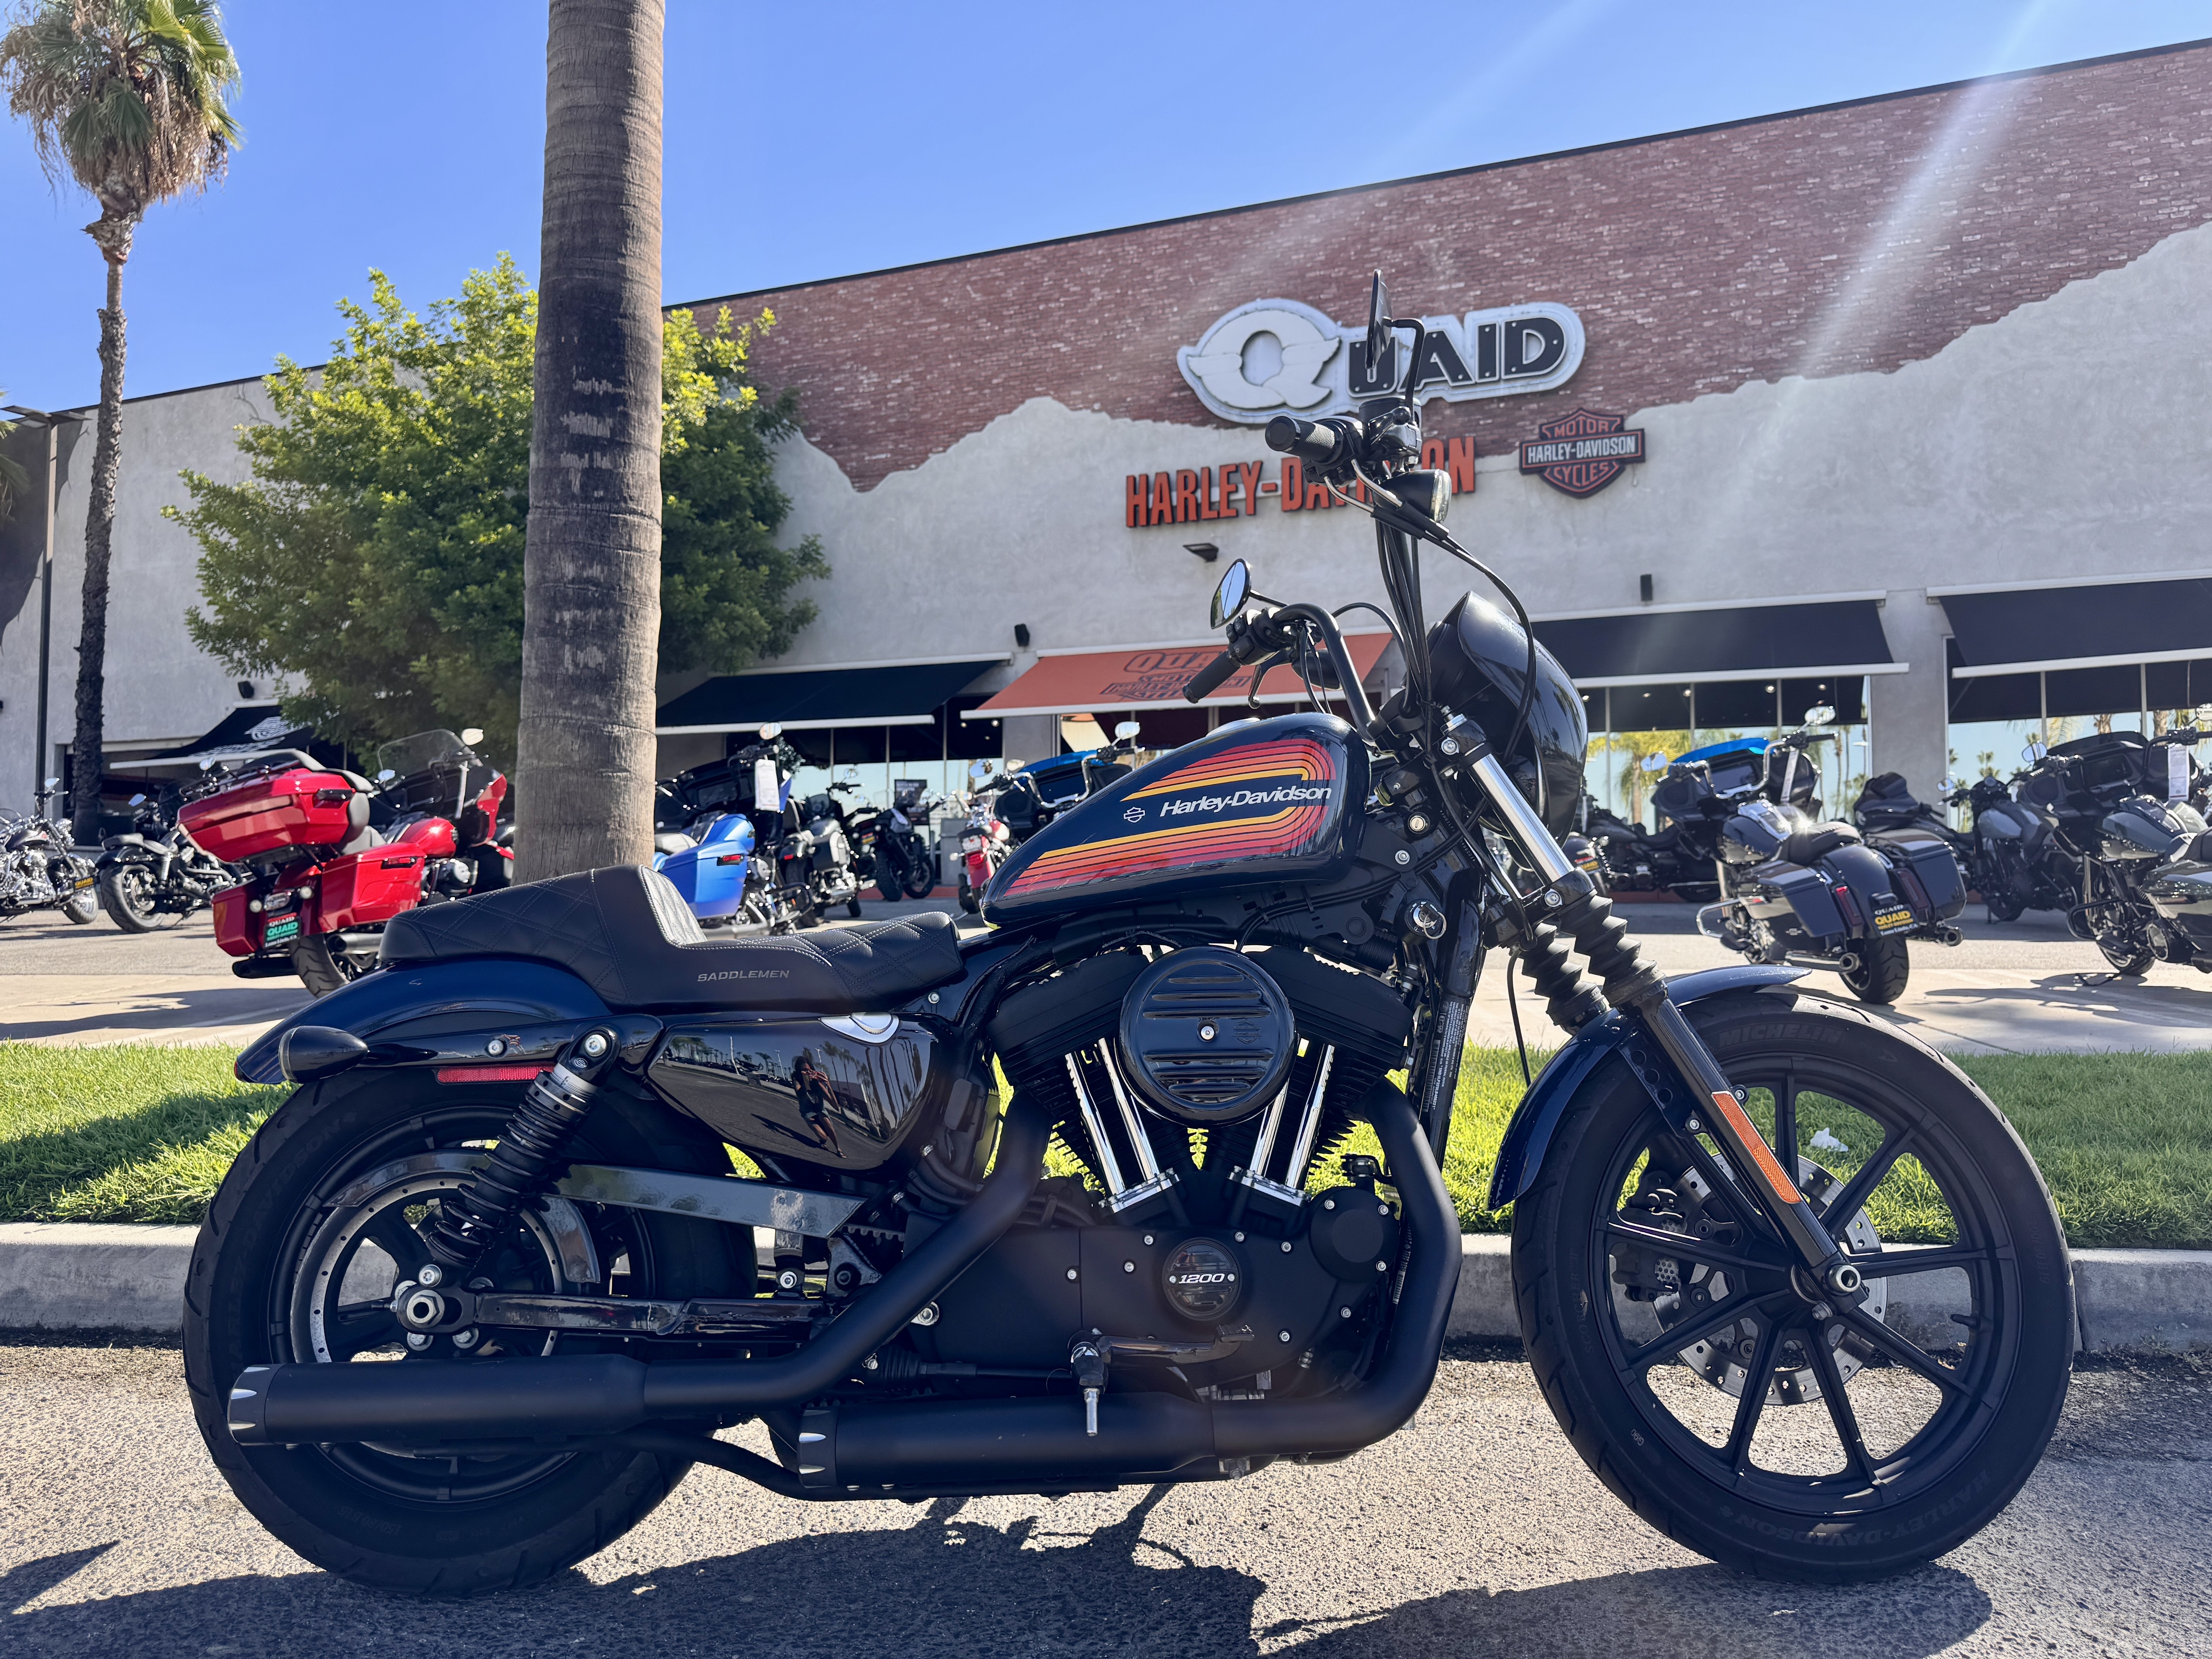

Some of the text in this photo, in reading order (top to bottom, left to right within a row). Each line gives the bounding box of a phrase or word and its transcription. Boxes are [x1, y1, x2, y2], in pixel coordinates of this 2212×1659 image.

[1187, 309, 1567, 410] QUAID
[1554, 416, 1609, 438] MOTOR
[1528, 435, 1636, 464] HARLEY-DAVIDSON
[1554, 462, 1609, 487] CYCLES
[1159, 786, 1331, 817] Harley-Davidson
[267, 922, 298, 936] QUAID
[1875, 910, 1911, 925] QUAID
[697, 970, 789, 982] SADDLEMEN
[1719, 1023, 1844, 1048] MICHELIN
[1178, 1273, 1225, 1284] 1200
